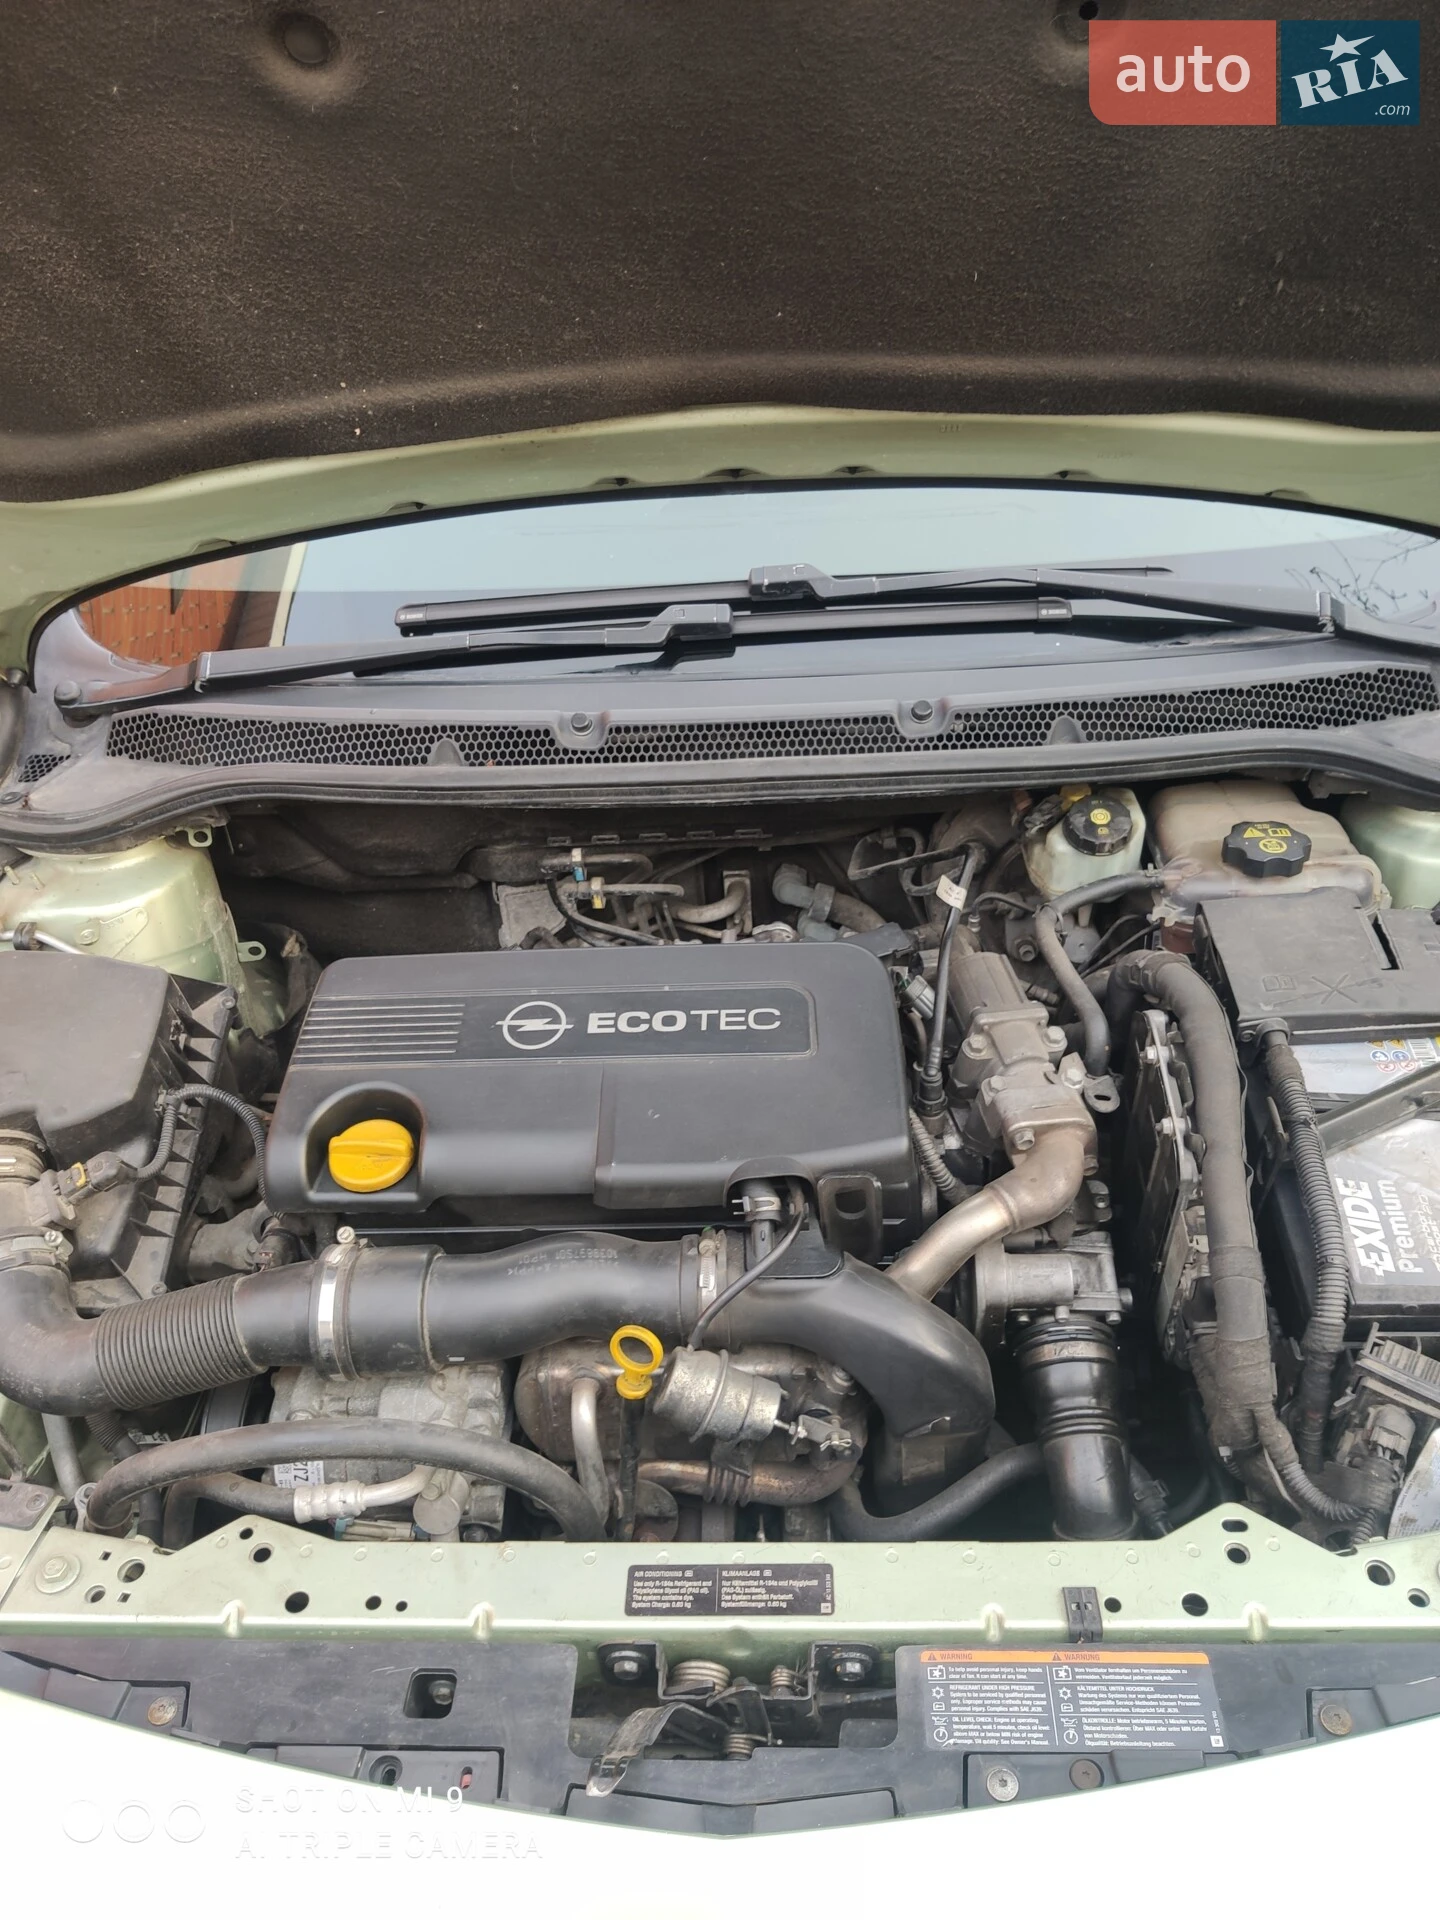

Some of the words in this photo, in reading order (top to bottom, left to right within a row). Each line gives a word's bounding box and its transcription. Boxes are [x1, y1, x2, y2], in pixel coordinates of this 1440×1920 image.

[587, 1008, 781, 1034] ECOTEC
[1335, 1177, 1396, 1273] EXIDE
[1377, 1180, 1424, 1273] Premium
